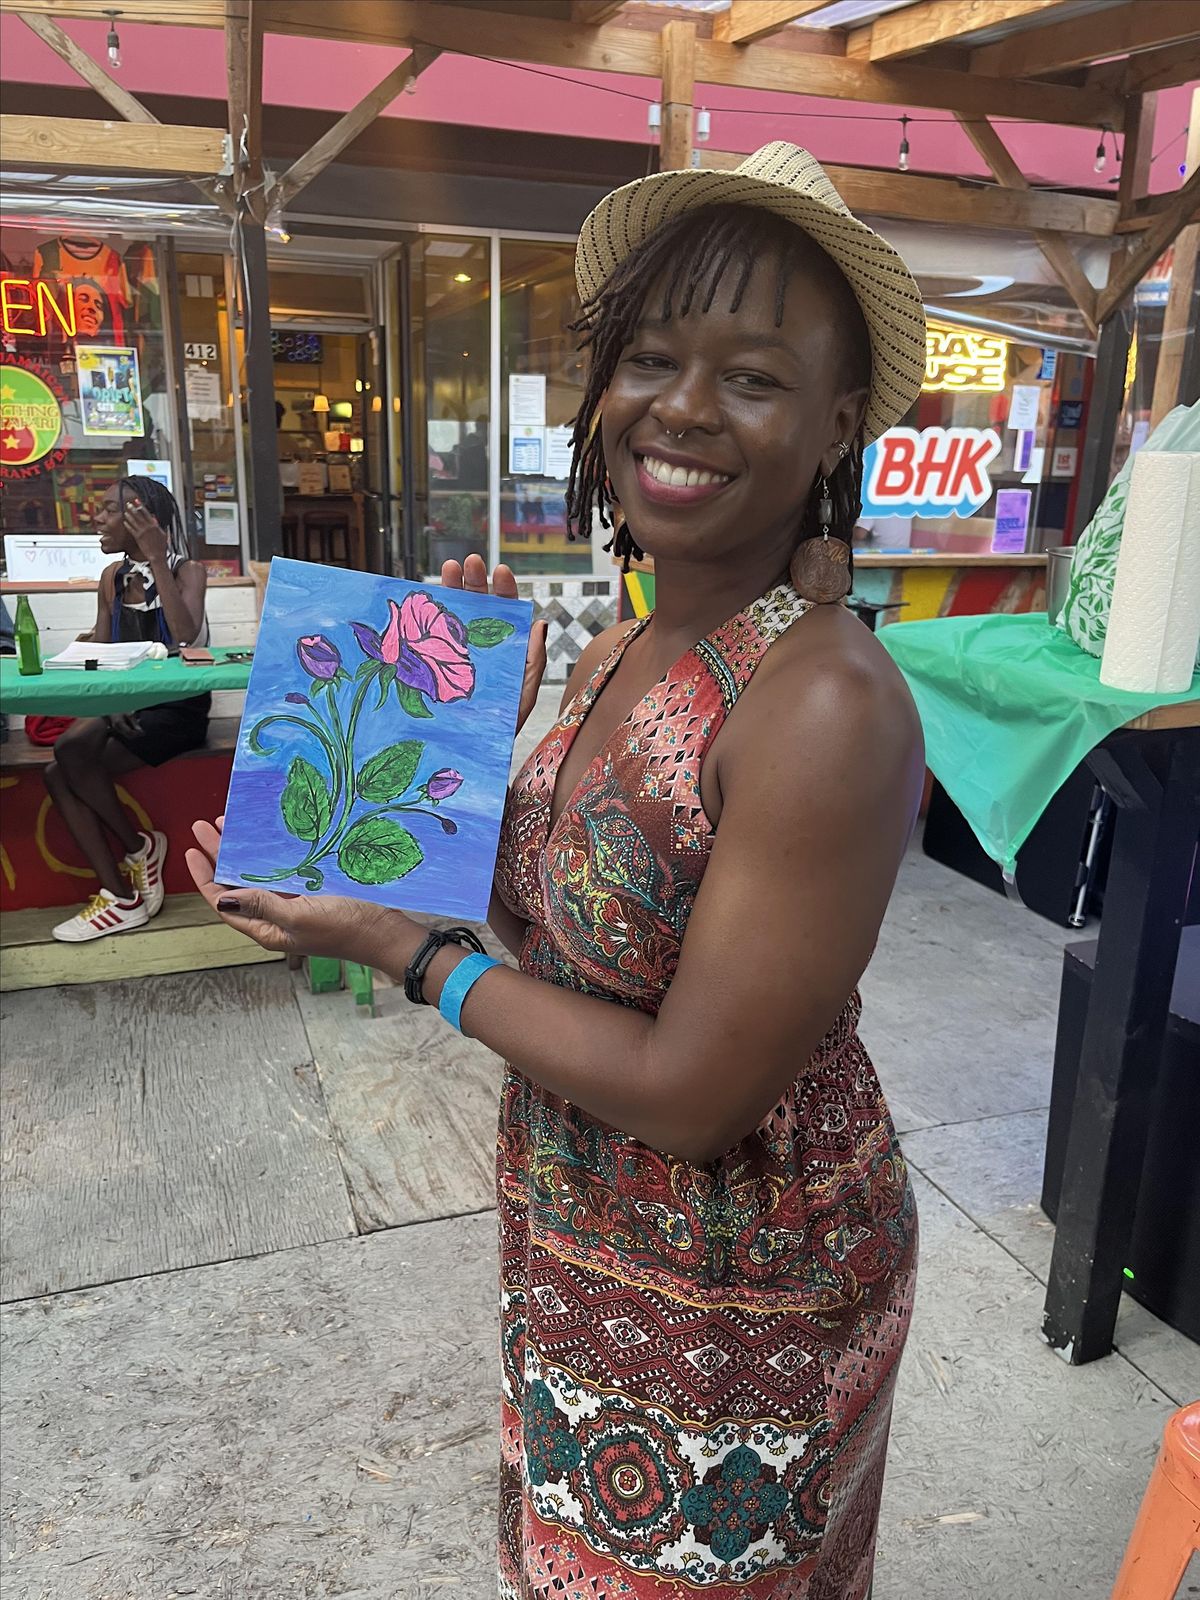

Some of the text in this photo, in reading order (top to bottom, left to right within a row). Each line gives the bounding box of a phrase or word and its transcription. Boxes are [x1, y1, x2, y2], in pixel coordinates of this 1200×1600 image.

[1, 279, 76, 336] EN
[186, 344, 214, 358] 412
[875, 437, 993, 497] BHK
